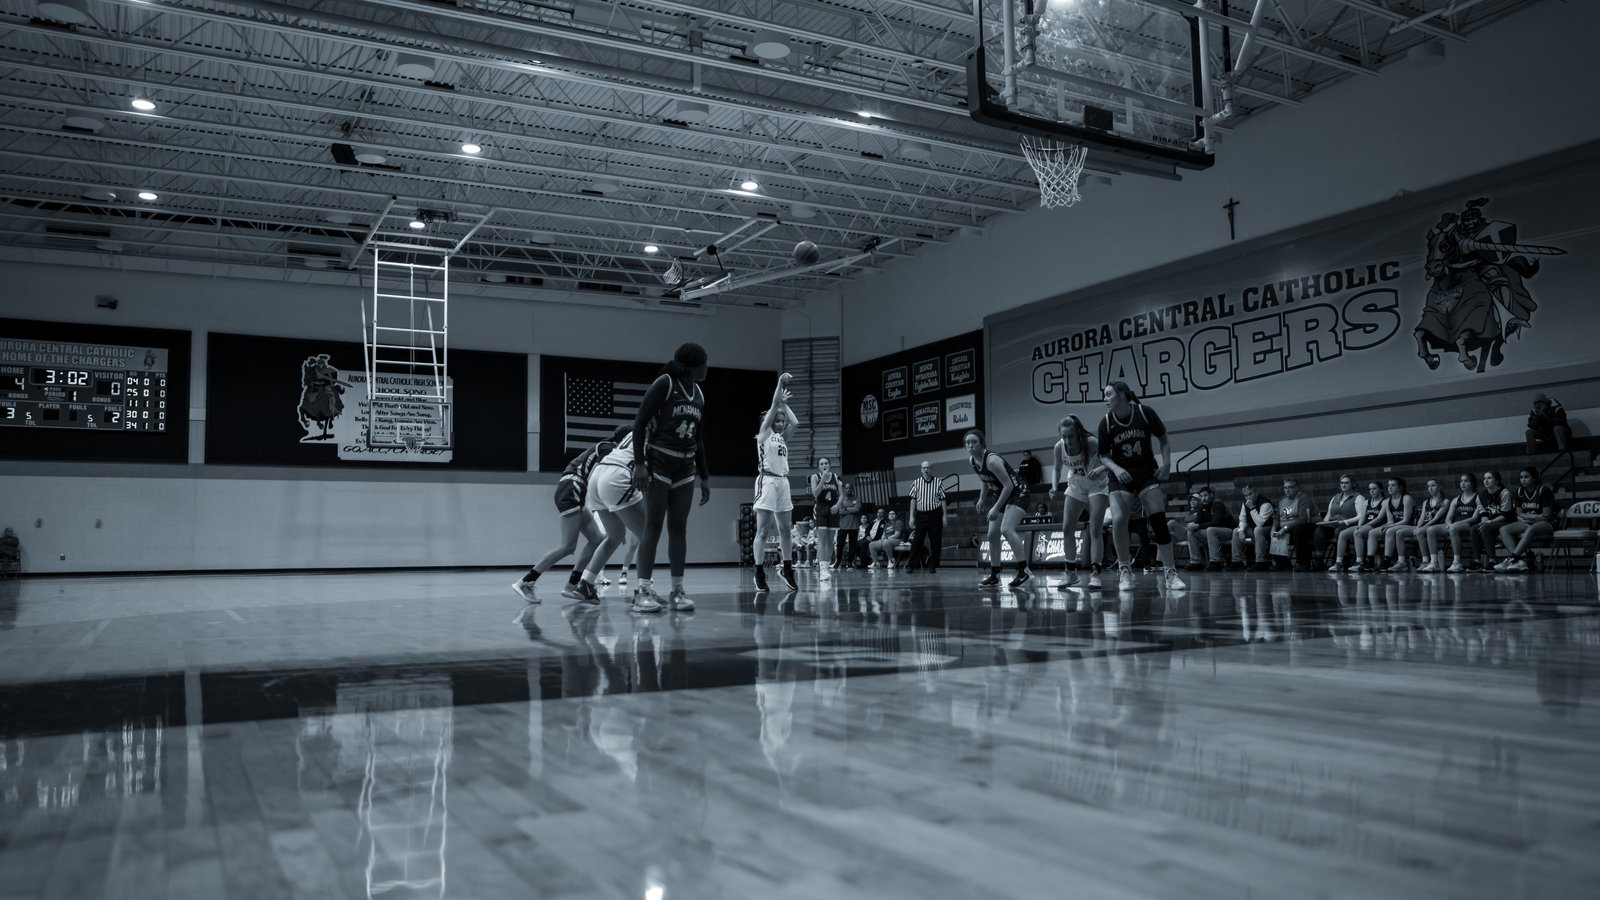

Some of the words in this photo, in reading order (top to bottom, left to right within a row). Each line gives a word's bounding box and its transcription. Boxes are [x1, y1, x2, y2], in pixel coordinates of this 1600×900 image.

[1031, 324, 1113, 361] AURORA
[1119, 293, 1234, 340] CENTRAL
[1242, 261, 1400, 312] CATHOLIC
[0, 341, 36, 352] URORA
[40, 343, 84, 355] CENTRAL
[86, 346, 135, 358] CATHOLIC
[1032, 288, 1401, 404] CHARGERS
[2, 351, 32, 362] HOME
[35, 353, 48, 362] OF
[51, 354, 70, 364] THE
[71, 355, 126, 368] CHARGERS
[1, 366, 25, 375] HOME
[95, 371, 124, 380] VISITOR
[14, 377, 25, 390] 4
[45, 369, 88, 386] 3:02
[127, 377, 139, 386] 04
[143, 378, 150, 386] 0
[160, 379, 166, 387] 0
[111, 382, 121, 395] 0
[143, 389, 150, 397] 0
[160, 390, 166, 398] 0
[159, 401, 165, 409] 0
[6, 407, 15, 419] 3
[111, 412, 120, 423] 2
[126, 410, 138, 419] 30
[142, 411, 149, 419] 0
[159, 412, 165, 420] 0
[125, 421, 137, 430] 34
[158, 422, 165, 431] 0
[1121, 440, 1142, 457] 34
[1574, 502, 1600, 515] ACC
